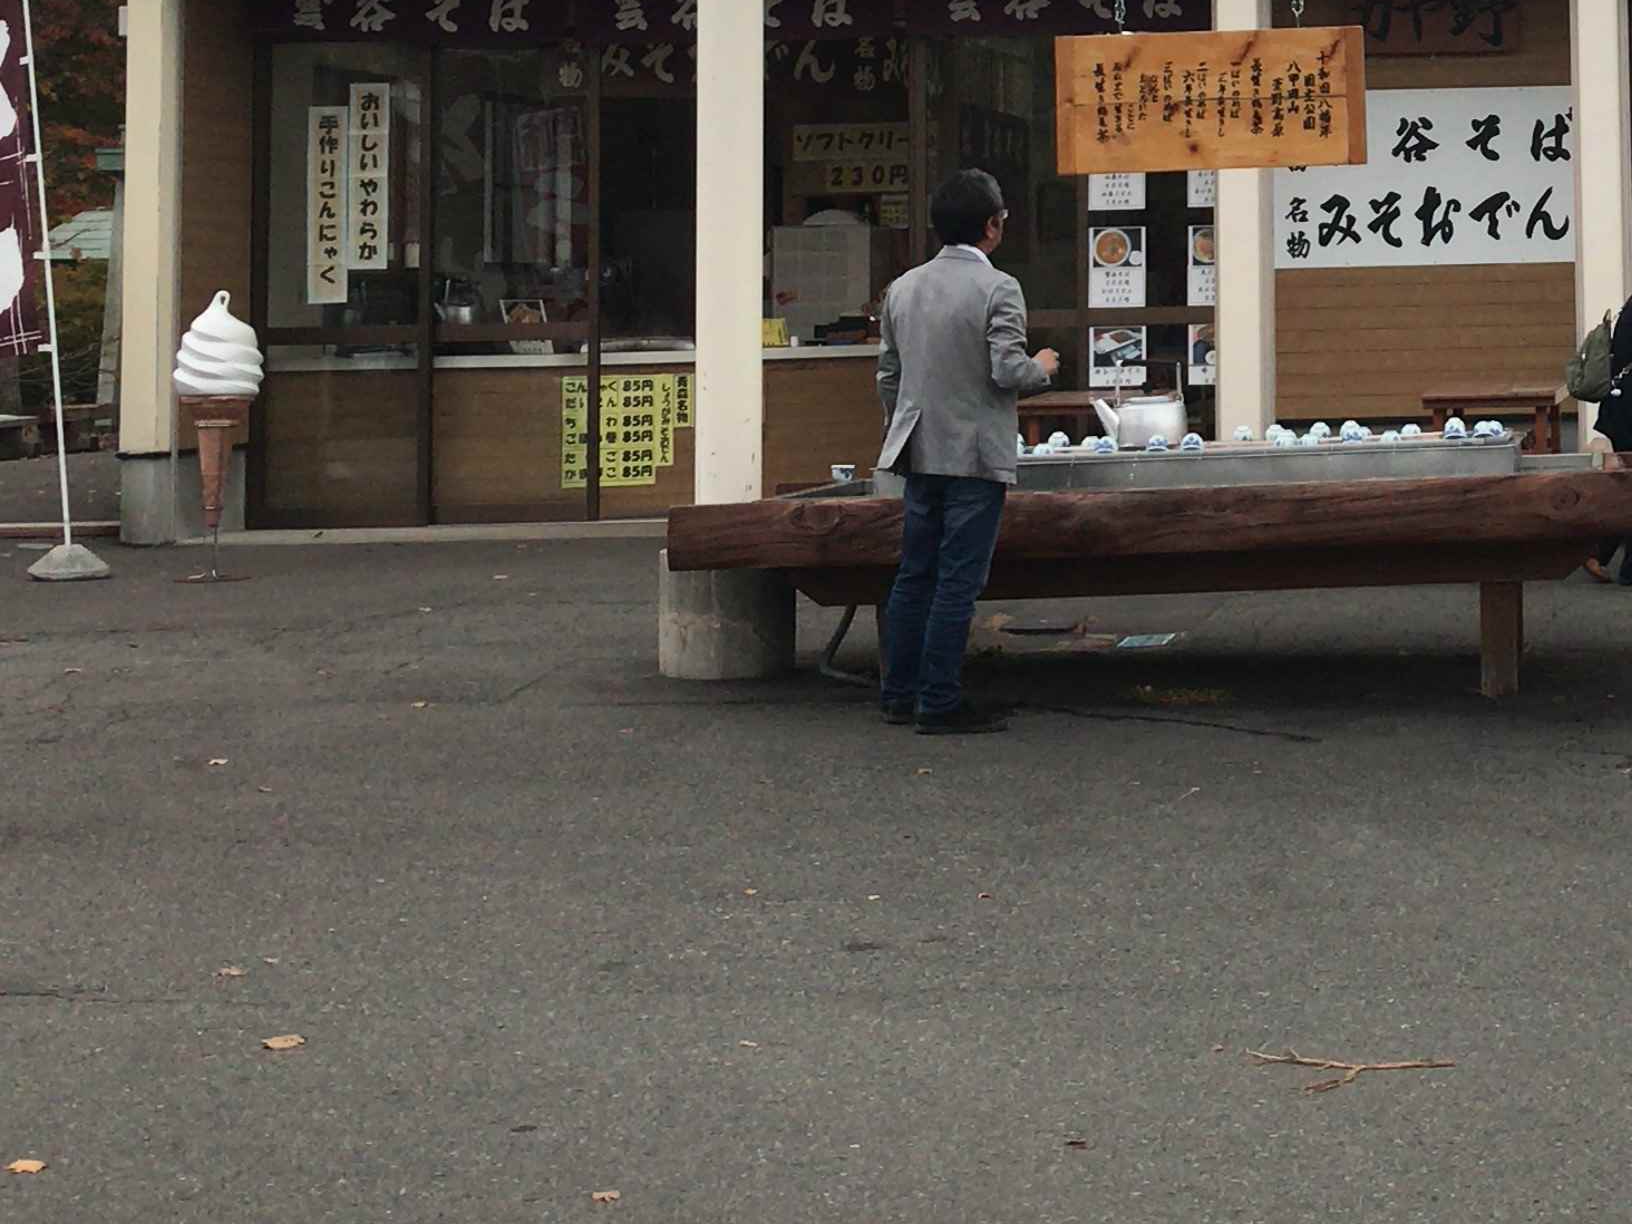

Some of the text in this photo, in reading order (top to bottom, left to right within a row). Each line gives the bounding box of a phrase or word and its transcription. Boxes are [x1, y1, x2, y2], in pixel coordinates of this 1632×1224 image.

[1287, 60, 1302, 115] 八甲田山
[358, 92, 380, 261] おいしいやわらか
[831, 163, 908, 186] 230円
[318, 114, 340, 285] 手作りこんにゃく
[1285, 185, 1572, 260] 名物 みそおでん
[565, 379, 654, 393] こんゃく 85円
[622, 395, 654, 408] 85円
[565, 414, 654, 429] ちわ 85円
[622, 430, 654, 443] 85円
[622, 449, 654, 463] 85円
[622, 465, 654, 478] 85円
